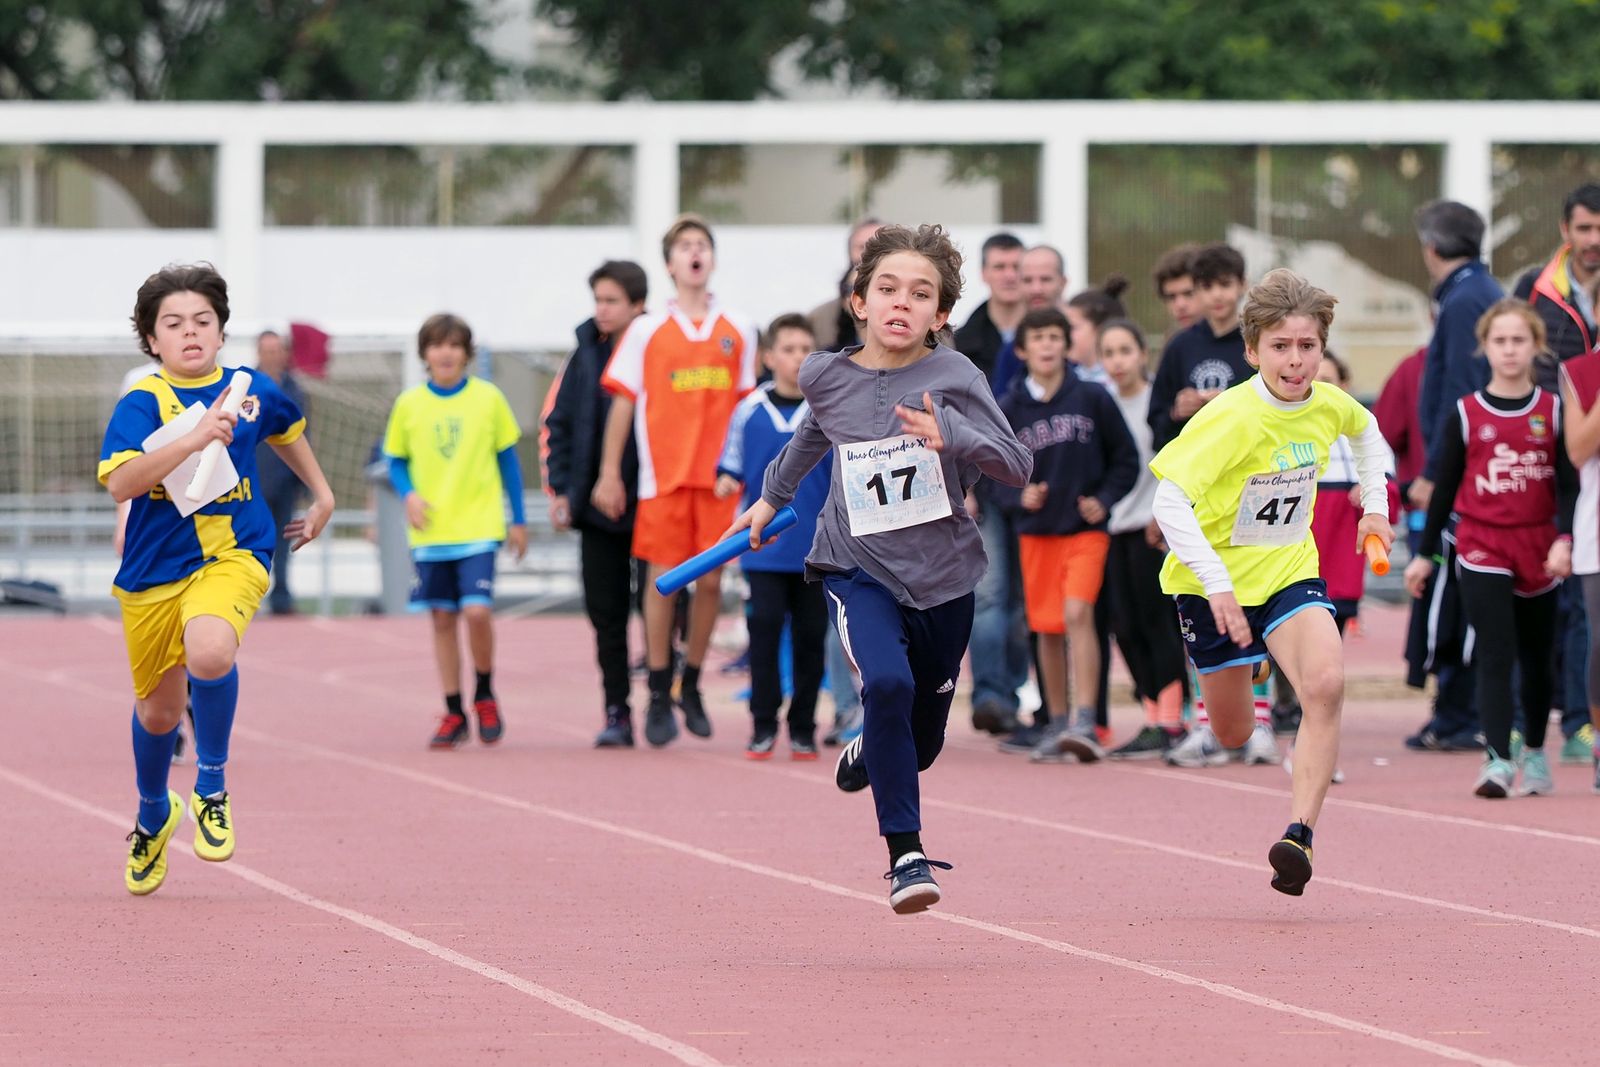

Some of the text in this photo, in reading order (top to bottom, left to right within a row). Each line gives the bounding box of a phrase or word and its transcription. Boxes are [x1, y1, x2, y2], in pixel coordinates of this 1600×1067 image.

[1494, 442, 1548, 465] San
[866, 465, 917, 506] 17
[1255, 496, 1301, 525] 47
